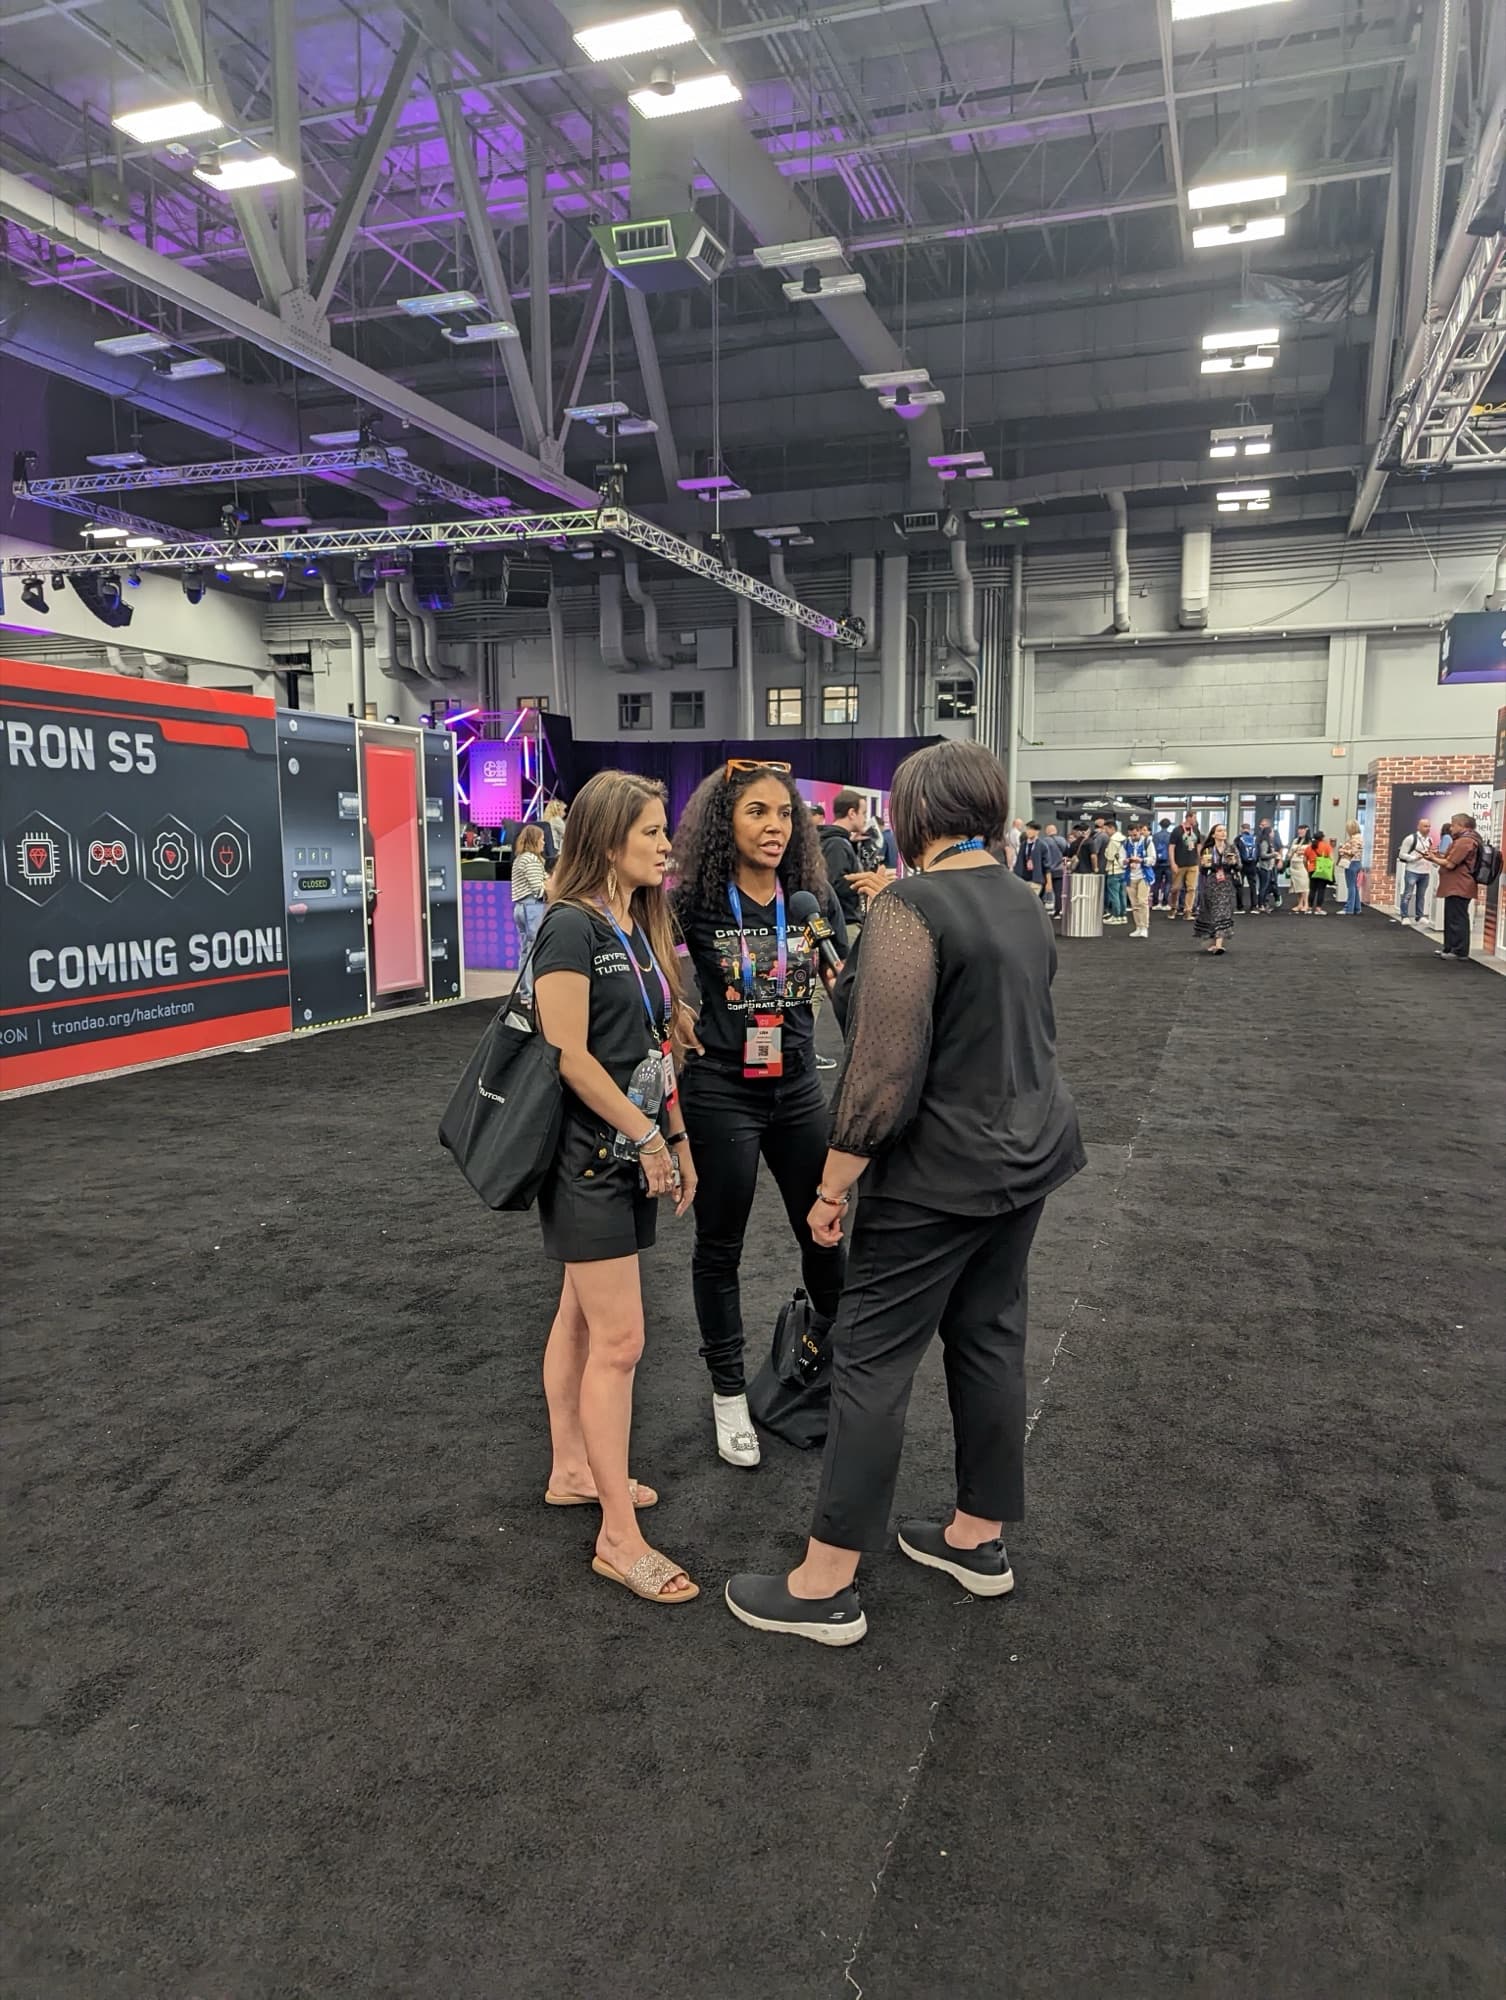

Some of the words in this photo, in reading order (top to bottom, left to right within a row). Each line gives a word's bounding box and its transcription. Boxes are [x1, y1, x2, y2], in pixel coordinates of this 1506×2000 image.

[108, 731, 157, 774] S5
[1473, 791, 1491, 799] Not
[1473, 801, 1489, 809] the
[302, 879, 328, 889] CLOSED
[715, 927, 768, 938] CRYPTO
[29, 937, 179, 993] COMING
[188, 926, 283, 973] SOON!
[51, 1001, 195, 1036] trondao.org/hackatron
